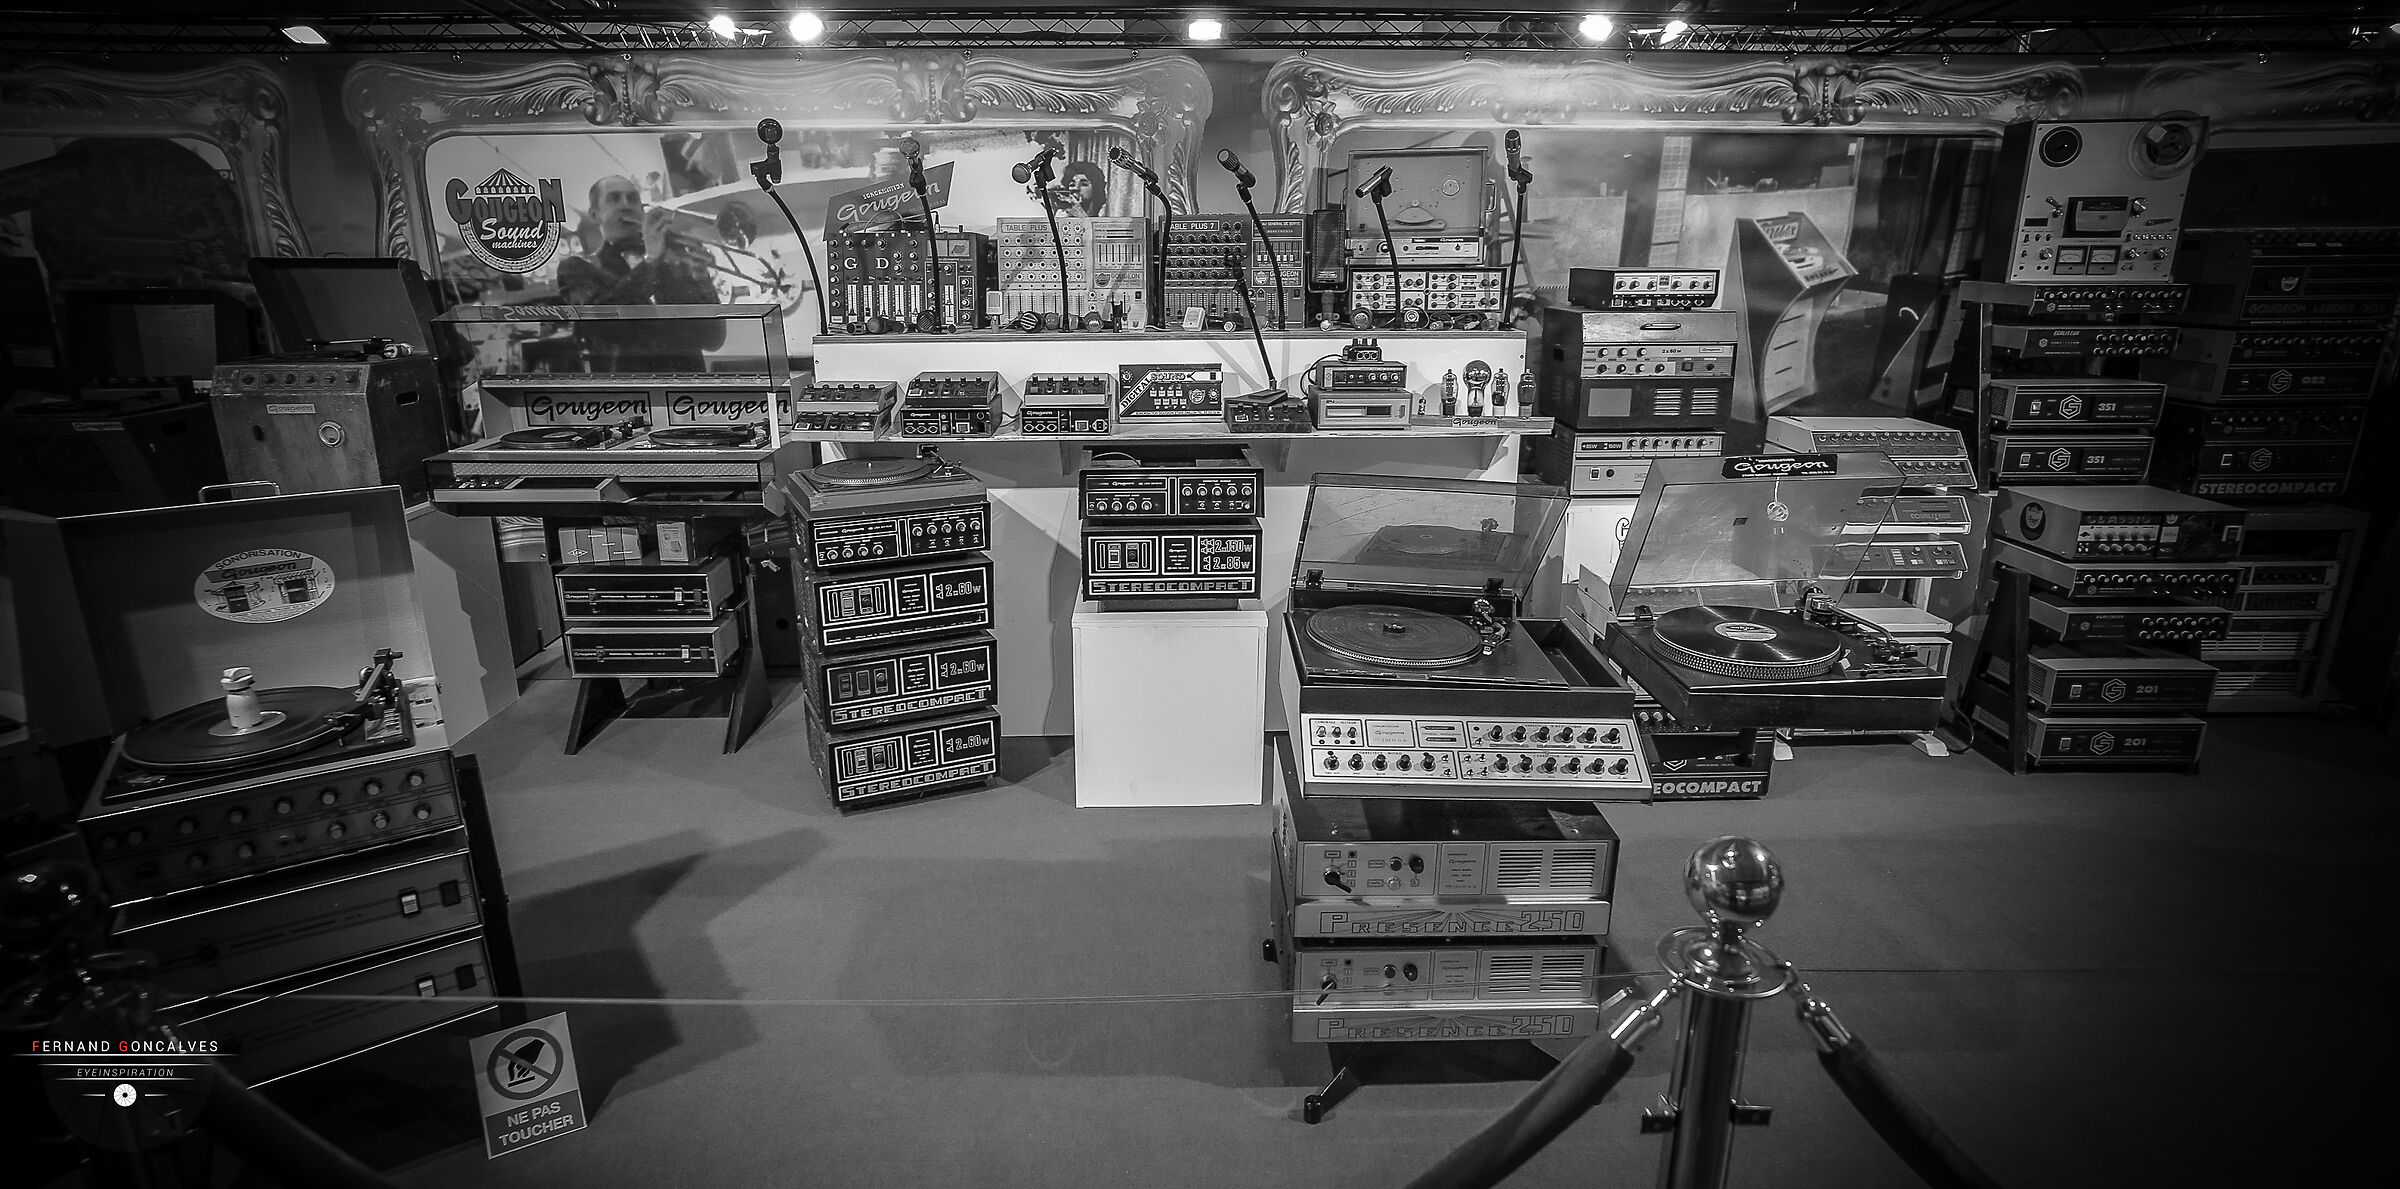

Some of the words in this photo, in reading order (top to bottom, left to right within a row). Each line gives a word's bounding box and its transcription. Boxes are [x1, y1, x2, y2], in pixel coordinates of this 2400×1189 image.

[445, 177, 567, 225] GOUGEON
[836, 180, 941, 223] Gougen
[480, 217, 545, 242] Sound
[1005, 224, 1027, 232] TABLE
[1030, 224, 1048, 232] PLUS
[1170, 223, 1188, 231] ABLE
[1190, 222, 1209, 231] PLUS
[491, 239, 539, 251] machines
[843, 257, 858, 270] G
[875, 257, 890, 270] D
[1121, 377, 1151, 409] DIGITAL
[531, 394, 648, 422] Gougeon
[672, 394, 791, 421] Gougeon
[2097, 402, 2117, 412] 351
[1452, 417, 1498, 428] Gougeon
[1733, 460, 1830, 474] Gougeon
[2086, 455, 2106, 464] 351
[2198, 481, 2337, 496] STEREOCOMPACT
[215, 549, 302, 570] SONORISATION
[1092, 579, 1252, 594] STEREOCOMPACT
[2135, 685, 2160, 694] 201
[834, 688, 988, 721] STEREOCOMPACT
[2123, 738, 2147, 747] 201
[841, 762, 993, 799] STEREOCOMPACT
[1652, 780, 1762, 796] EOCOMPACT
[1520, 909, 1585, 933] 250
[1511, 1014, 1575, 1038] 250
[507, 1110, 530, 1128] NE
[531, 1101, 561, 1120] PAS
[498, 1115, 574, 1147] TOUCHER
